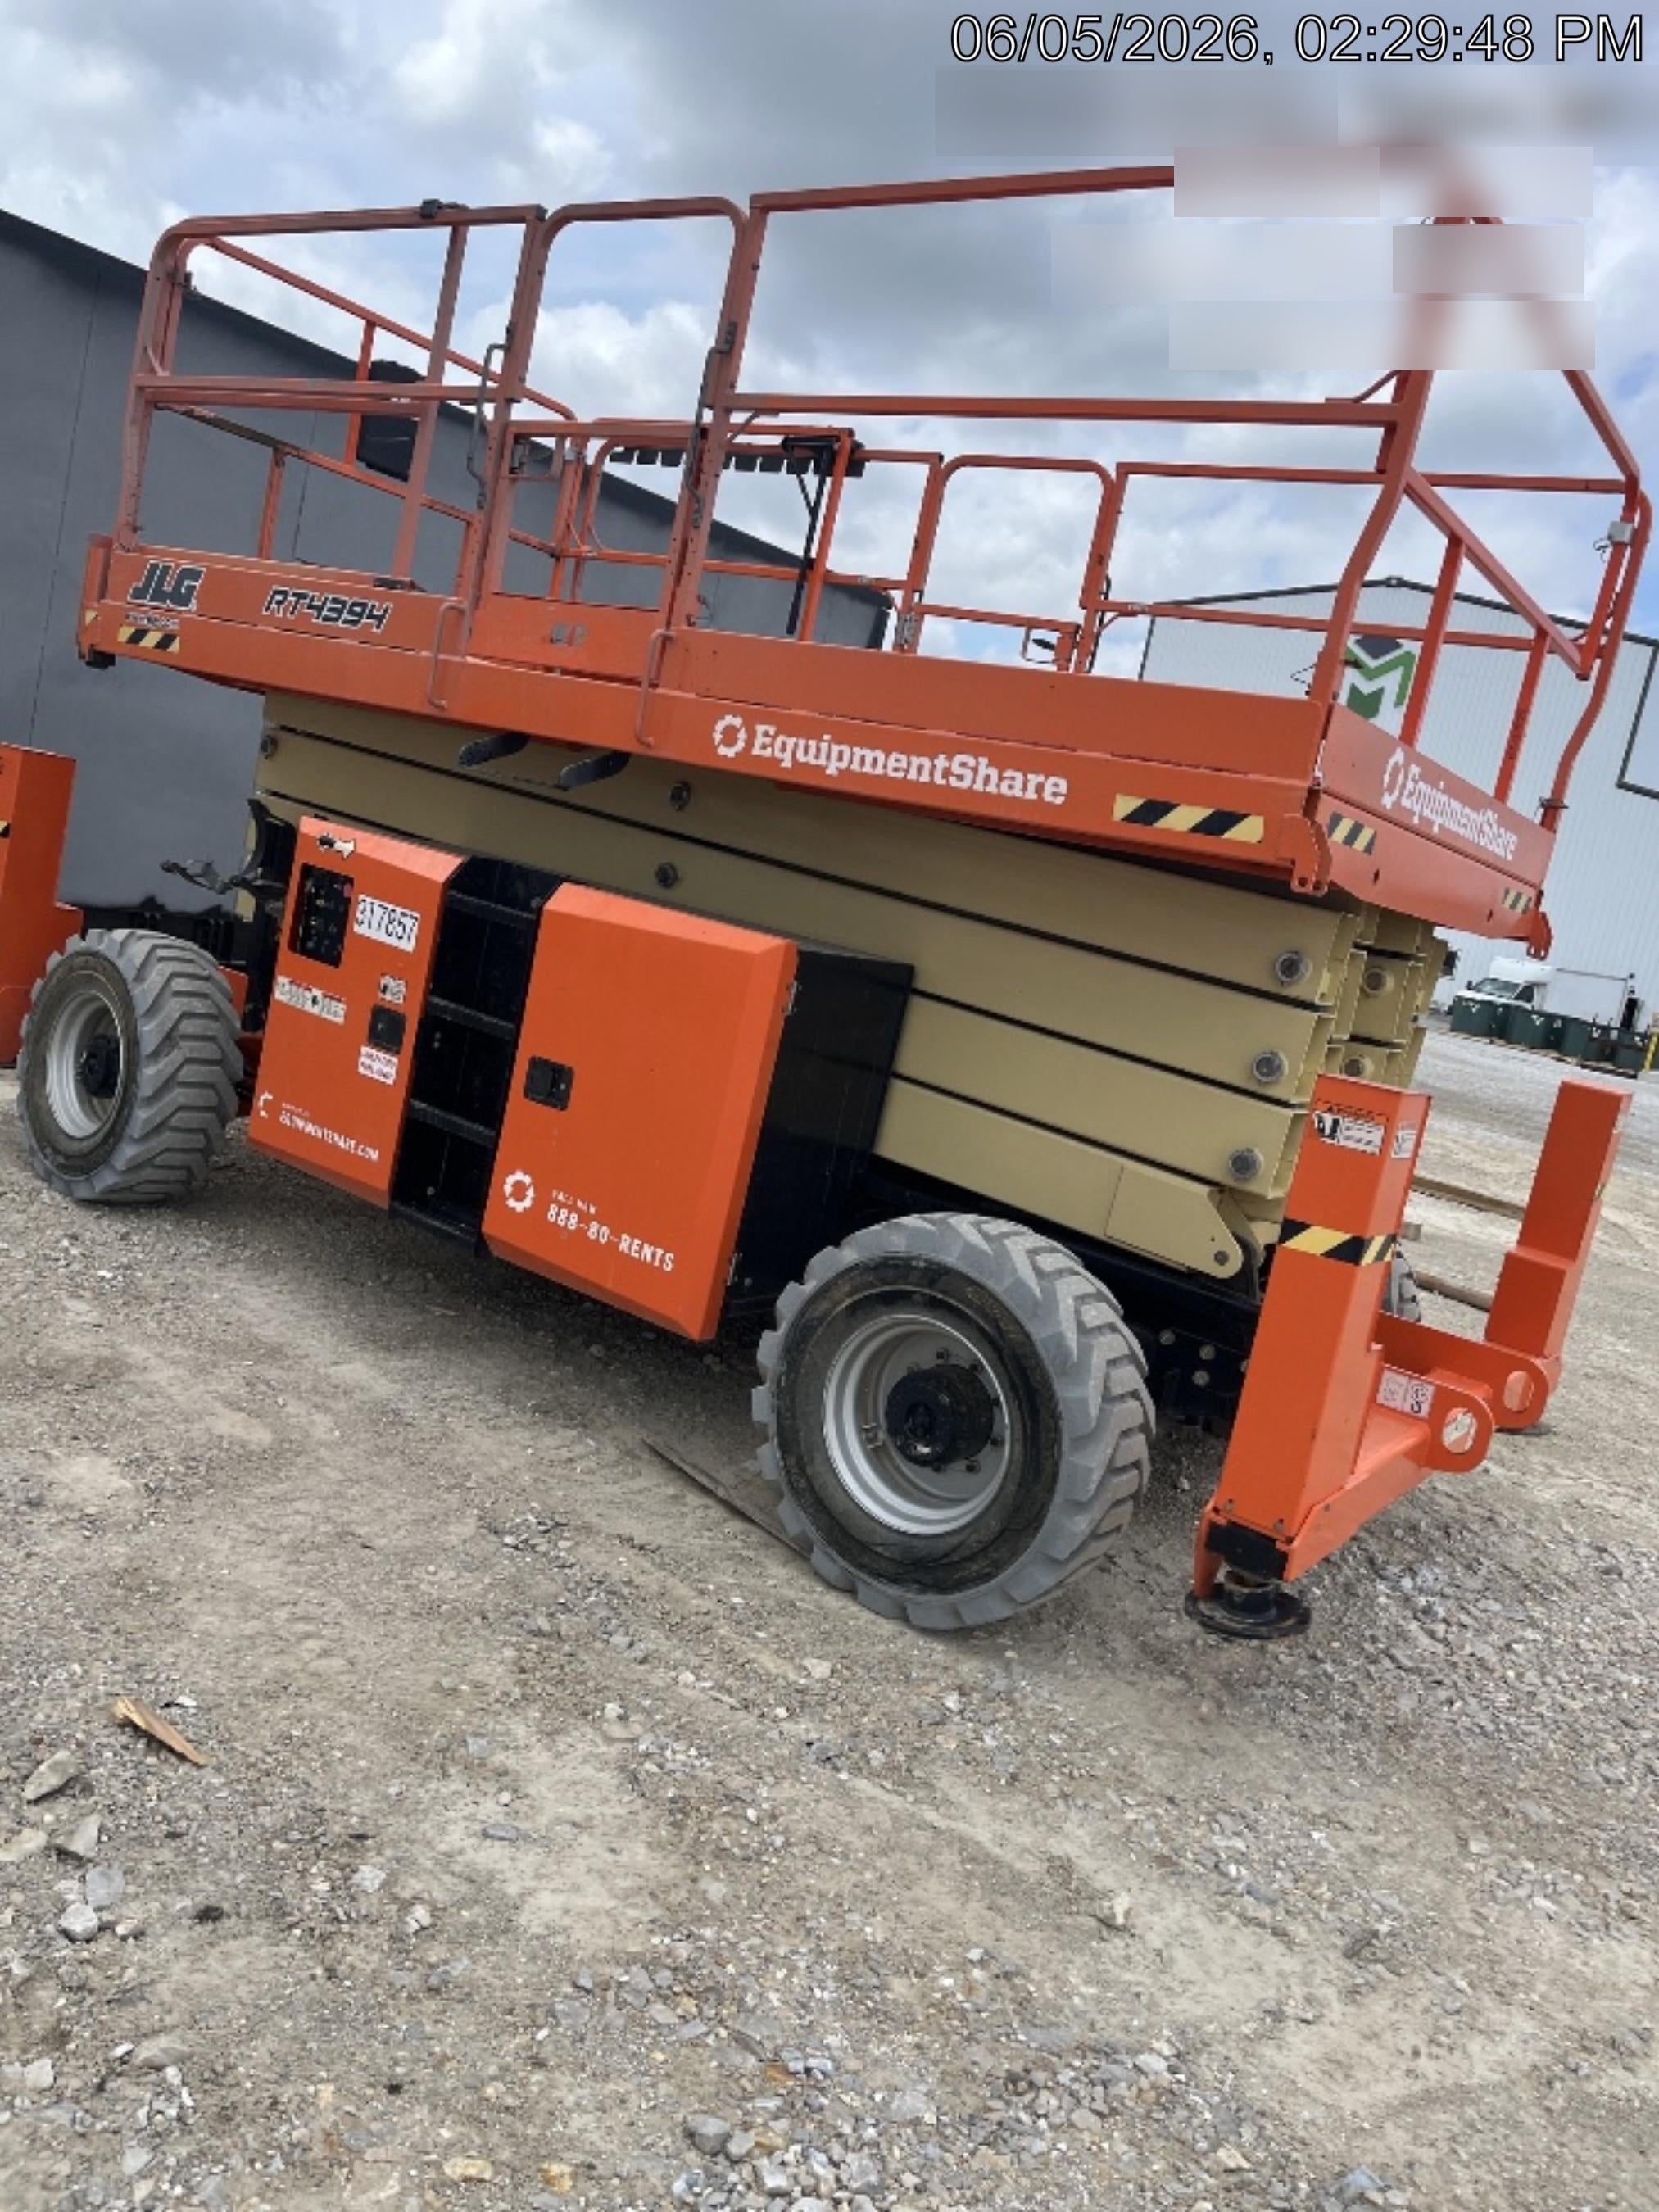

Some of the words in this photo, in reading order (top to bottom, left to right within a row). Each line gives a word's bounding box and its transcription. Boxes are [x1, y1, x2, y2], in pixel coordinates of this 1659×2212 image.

[126, 560, 206, 611] JLG
[262, 584, 393, 633] RT4394
[750, 724, 1068, 805] EquipmentShare
[356, 898, 419, 943] 317857
[546, 1203, 674, 1271] 888-80-RENTS
